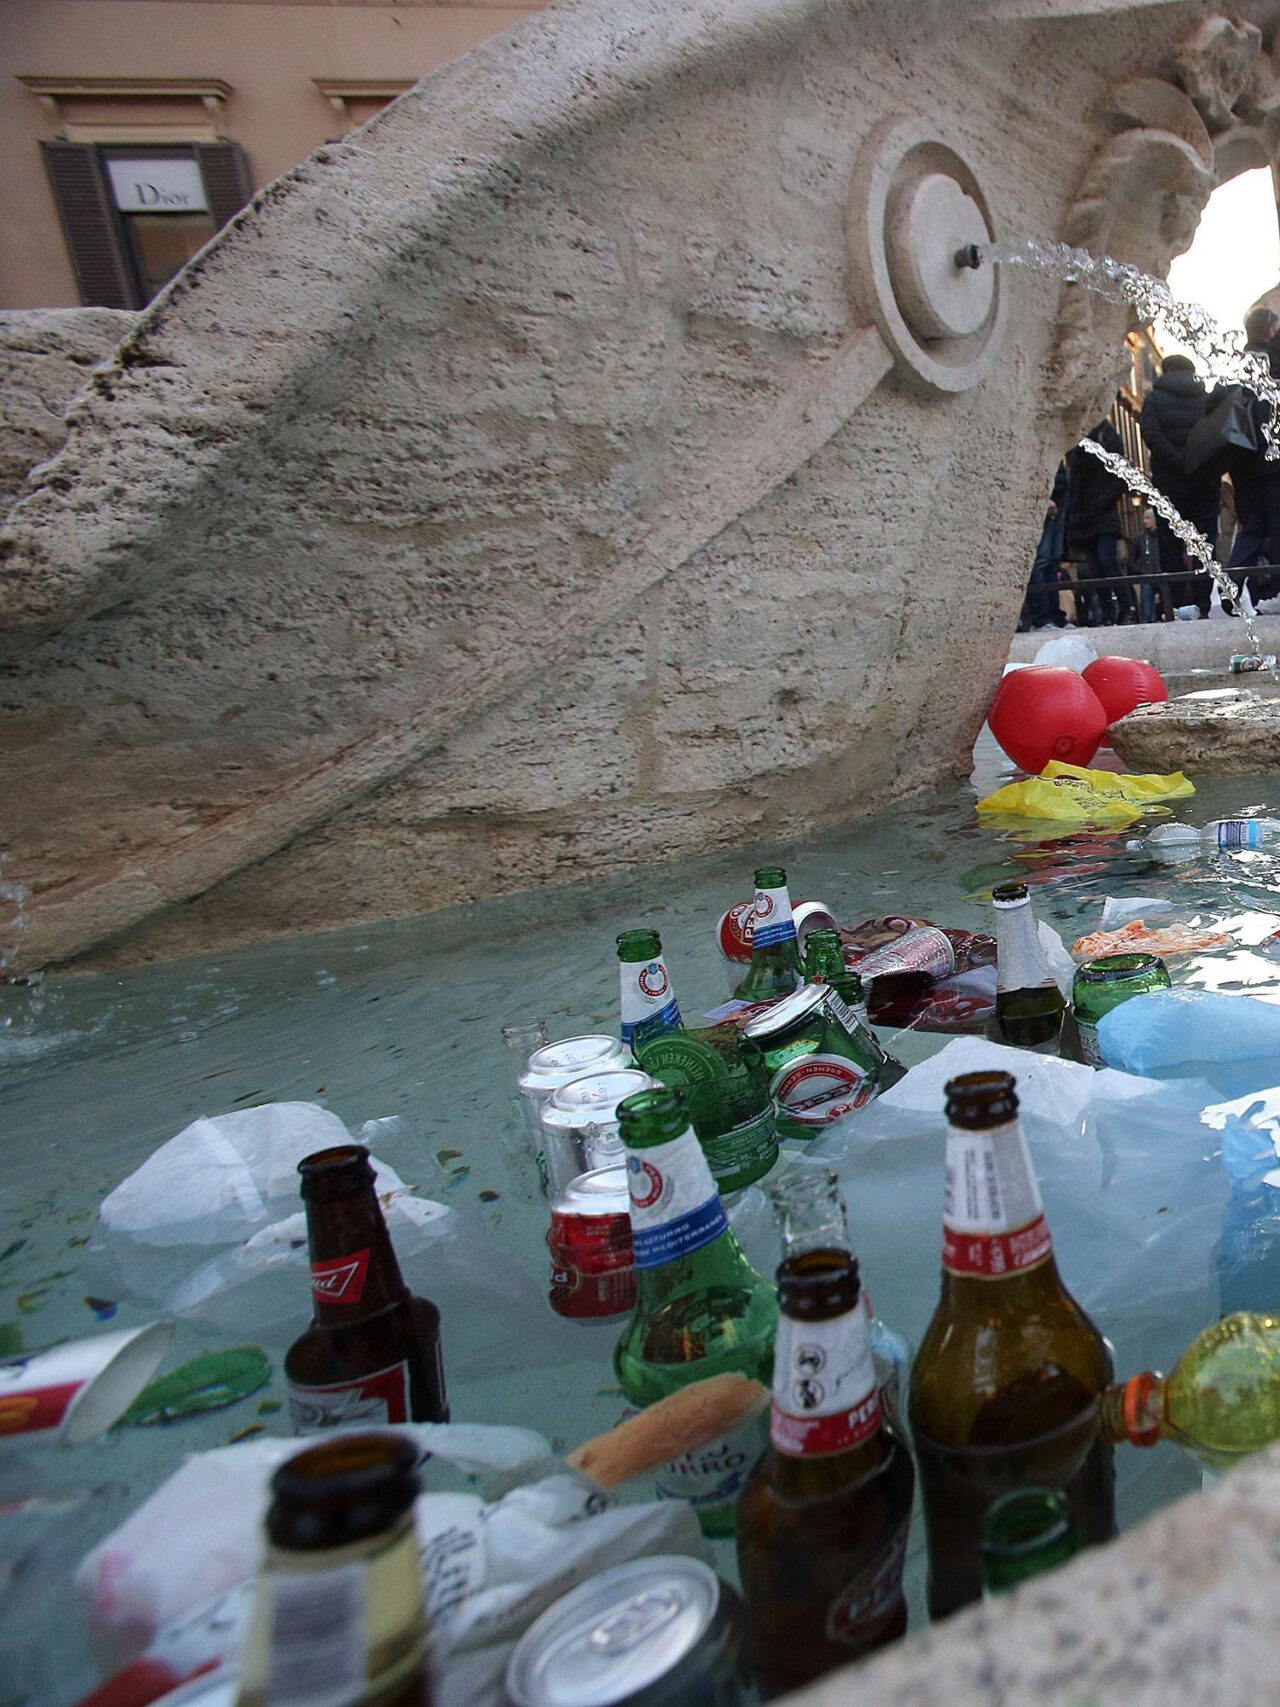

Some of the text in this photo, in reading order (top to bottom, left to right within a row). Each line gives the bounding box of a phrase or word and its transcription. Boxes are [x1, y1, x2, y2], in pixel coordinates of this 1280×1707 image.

[134, 181, 191, 205] Dior
[312, 1273, 338, 1289] ud
[848, 1400, 876, 1430] PER
